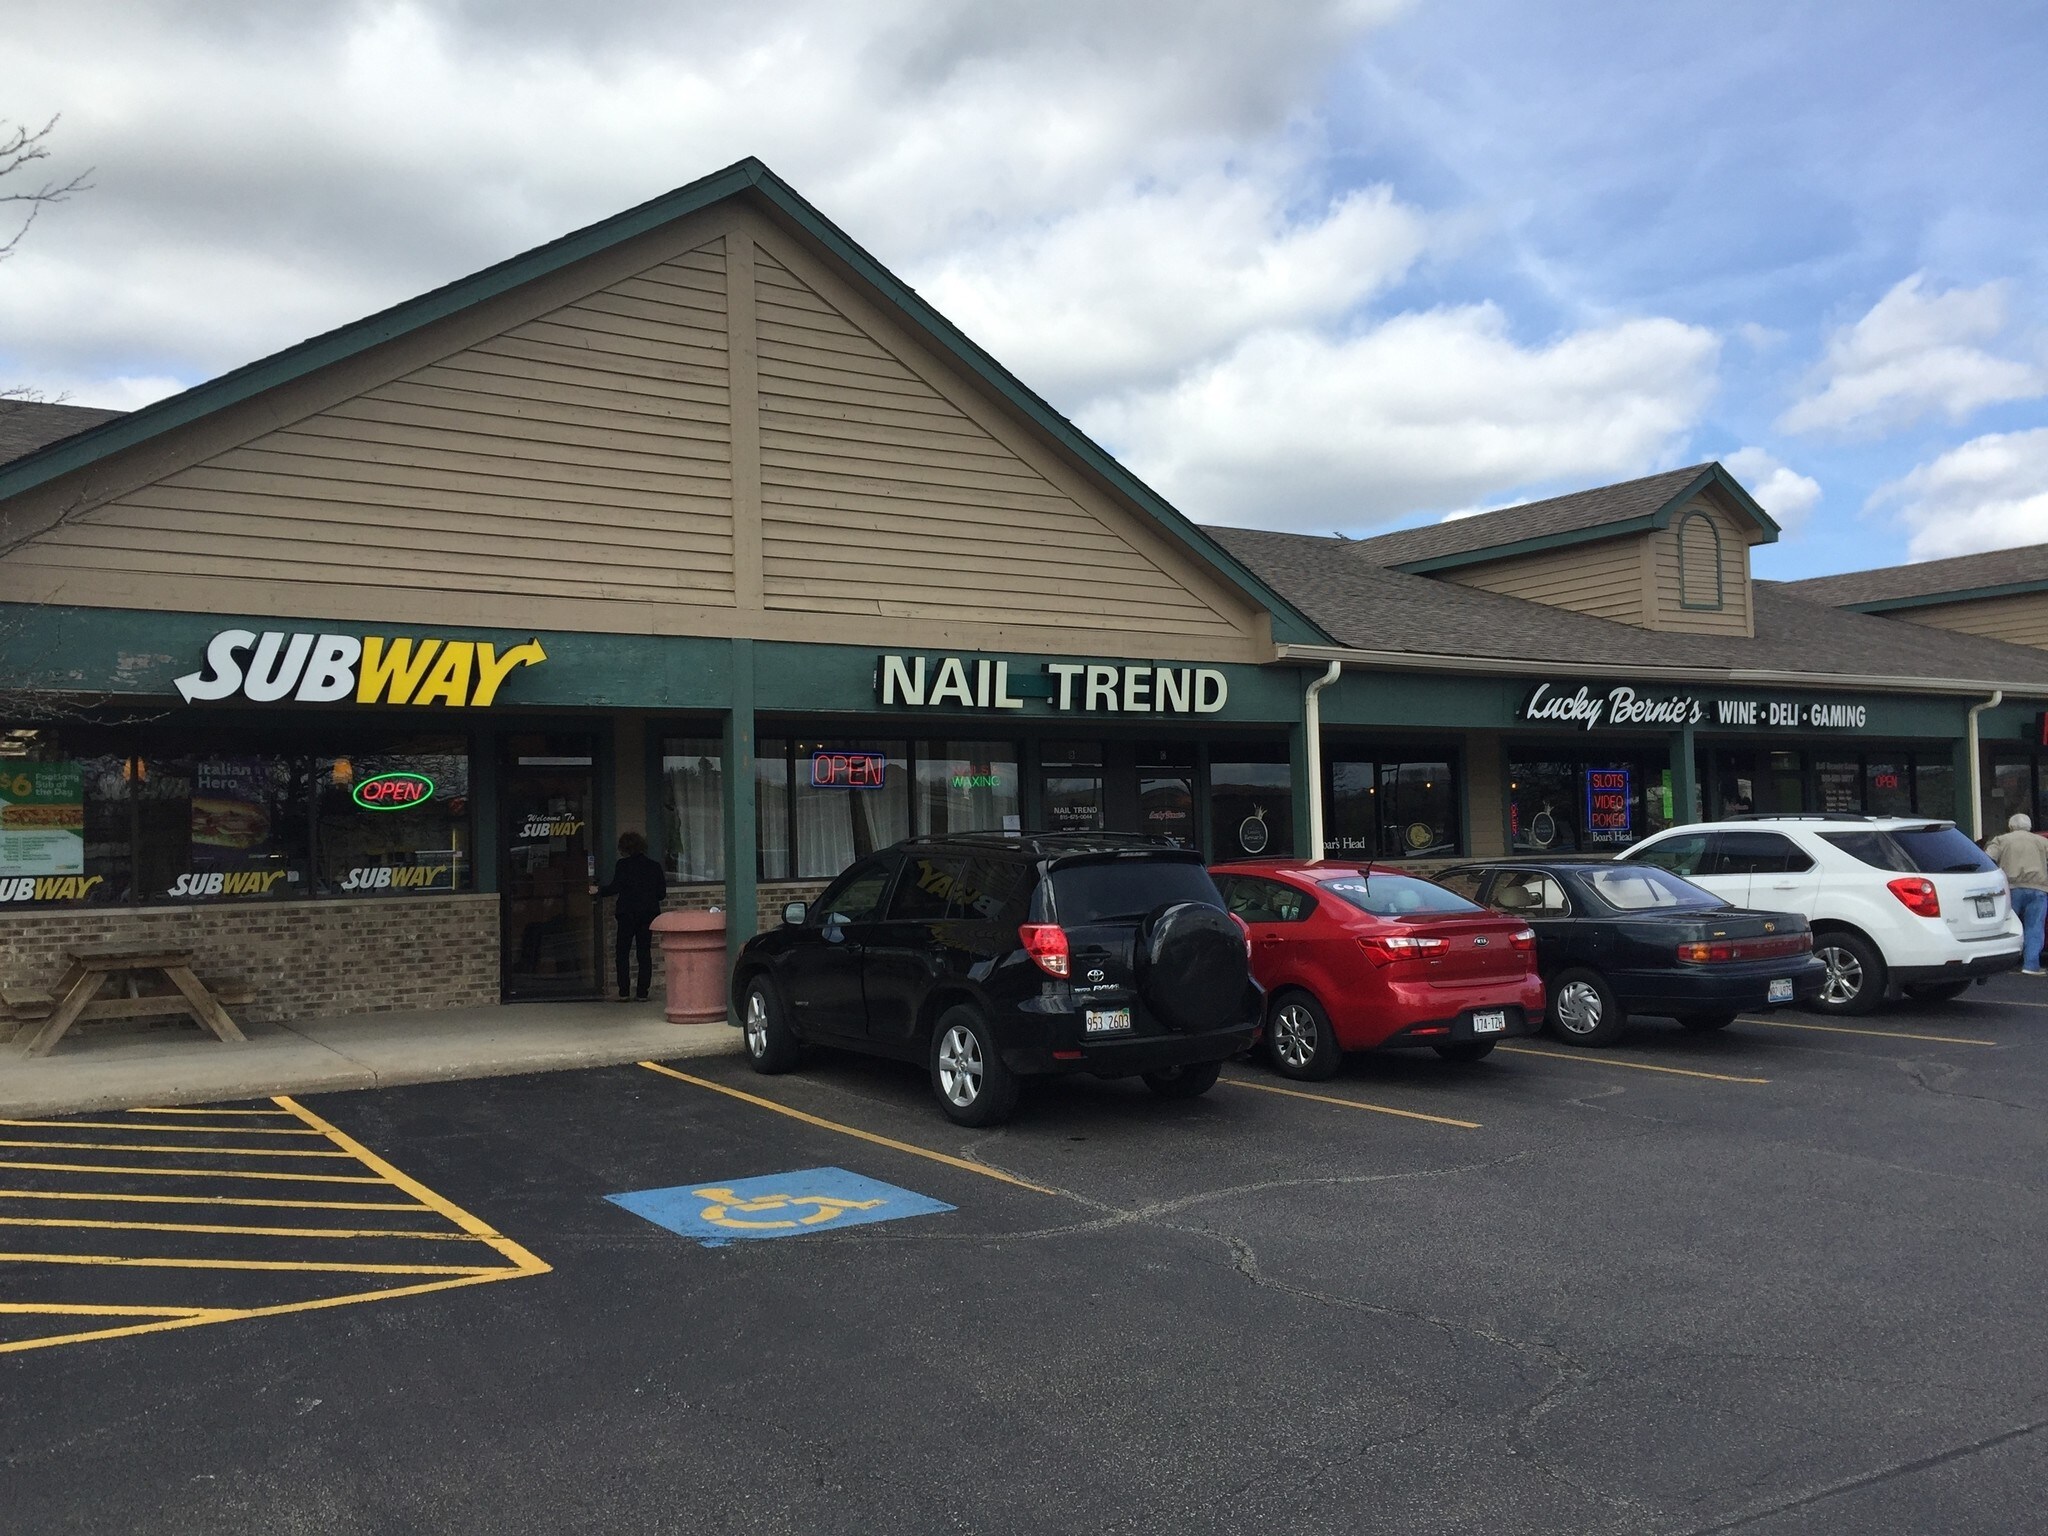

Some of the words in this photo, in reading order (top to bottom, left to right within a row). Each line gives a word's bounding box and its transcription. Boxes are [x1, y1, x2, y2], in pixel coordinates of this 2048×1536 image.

[173, 629, 548, 707] SUBWAY
[882, 655, 1024, 709] NAIL
[1047, 663, 1229, 714] TREND
[1526, 682, 1604, 731] Lucky
[1607, 686, 1703, 725] Bernie's
[1717, 700, 1757, 725] WINE
[1769, 702, 1799, 726] DELI
[1810, 703, 1867, 728] GAMING
[198, 762, 251, 776] Italian
[813, 754, 883, 786] OPEN
[35, 773, 80, 782] Footlong
[35, 781, 55, 789] Sub
[57, 780, 67, 788] of
[199, 776, 238, 789] Hero
[1592, 774, 1624, 788] SLOTS
[1876, 775, 1898, 788] OPEN
[35, 788, 53, 796] the
[54, 788, 74, 797] Day
[363, 781, 424, 801] OPEN
[1594, 795, 1624, 809] VIDEO
[1053, 806, 1071, 814] NAIL
[1073, 806, 1098, 814] TREND
[527, 814, 561, 822] Welcome
[564, 813, 575, 821] To
[1592, 813, 1626, 827] POKER
[519, 822, 585, 838] SUBWAY
[1592, 831, 1613, 842] Boar's
[1614, 830, 1633, 841] Head
[1323, 837, 1340, 849] oar's
[1343, 837, 1366, 849] Head
[167, 869, 286, 897] SUBWAY
[341, 864, 448, 890] SUBWAY
[0, 874, 104, 901] UBWAY
[1087, 1016, 1103, 1031] 953
[1108, 1014, 1129, 1029] 2603
